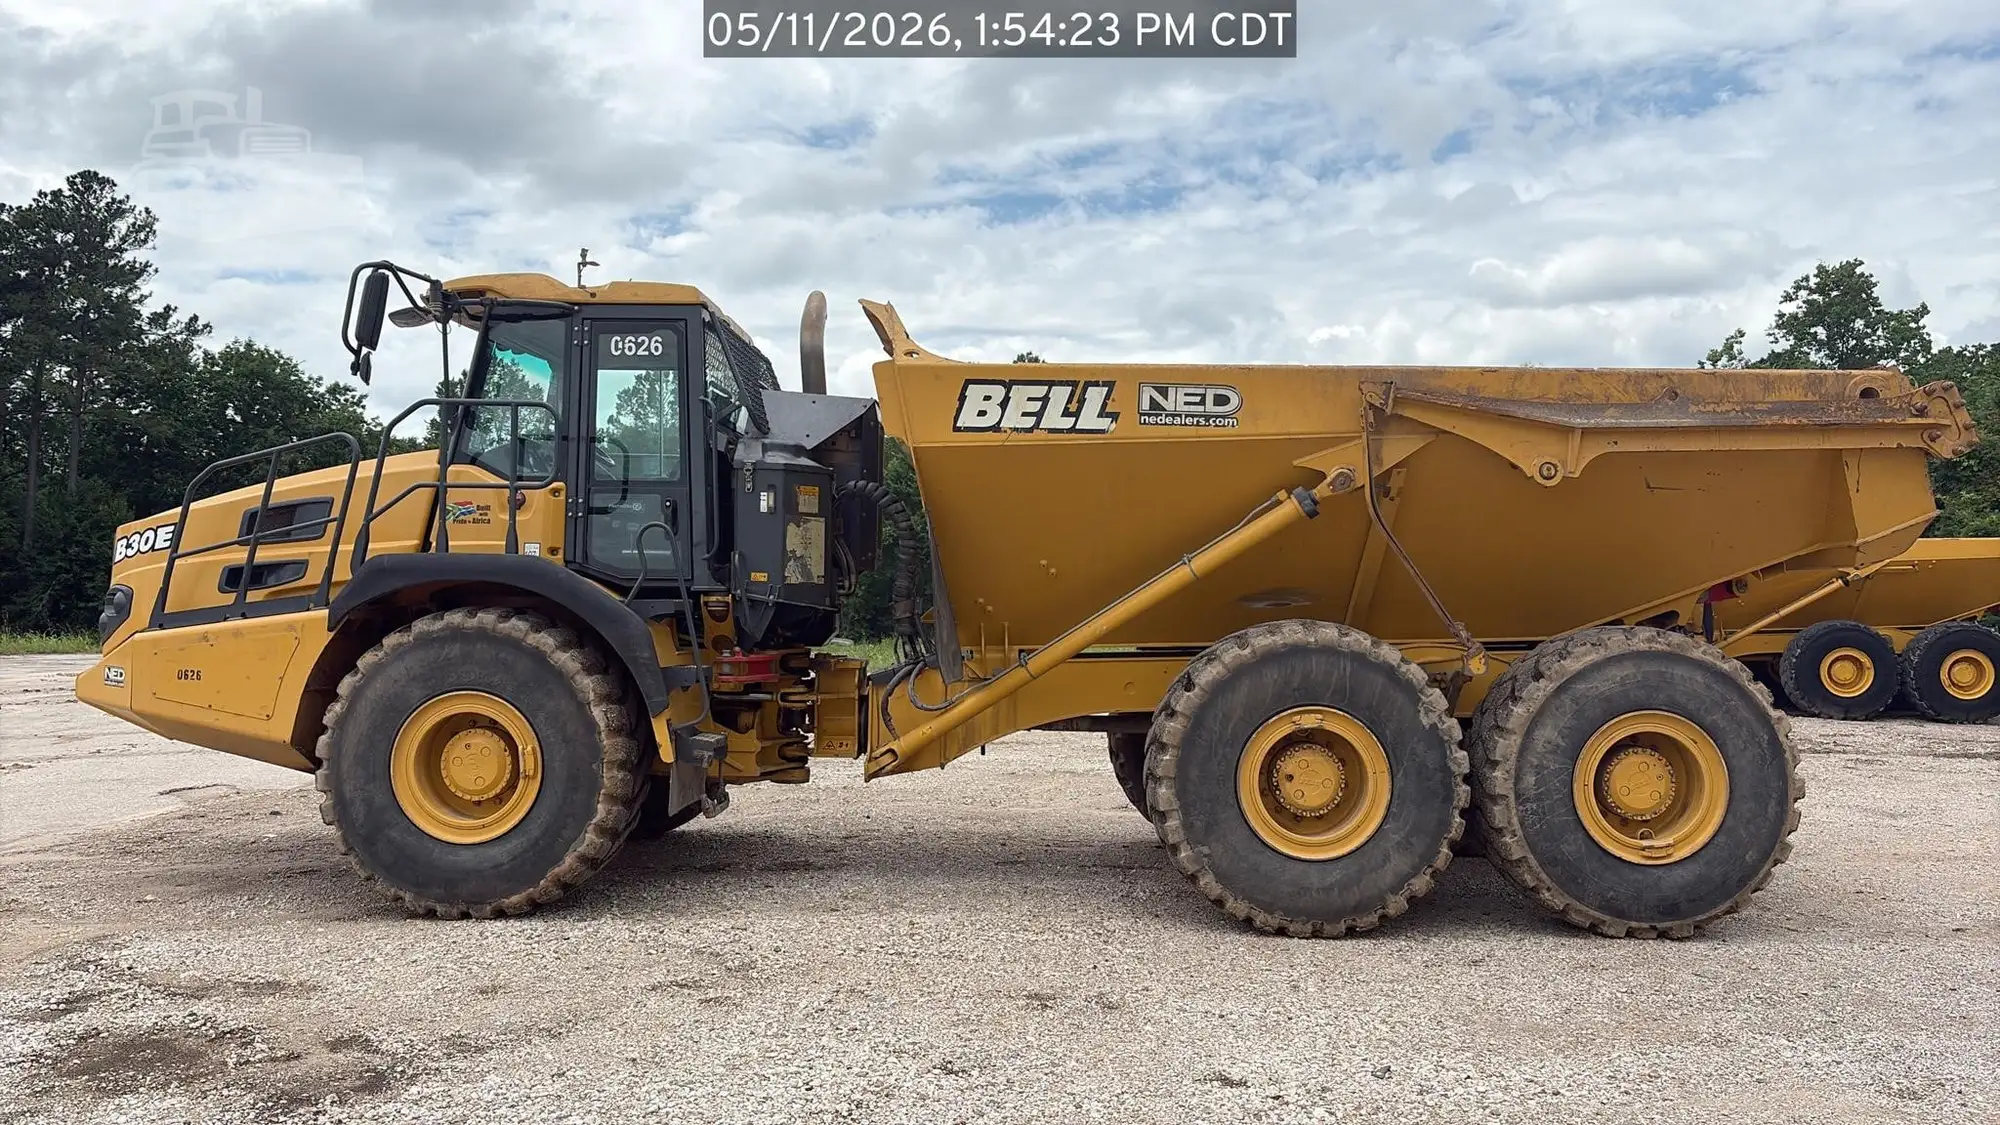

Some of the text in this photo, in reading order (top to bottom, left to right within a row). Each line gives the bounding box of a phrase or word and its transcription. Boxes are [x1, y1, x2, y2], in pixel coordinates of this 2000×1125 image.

[610, 335, 663, 356] 0626
[955, 381, 1117, 431] BELL
[1139, 382, 1243, 416] NED
[1140, 415, 1238, 427] nedealers.com
[114, 524, 176, 563] B30E
[104, 666, 126, 681] NED
[176, 668, 202, 681] 0626
